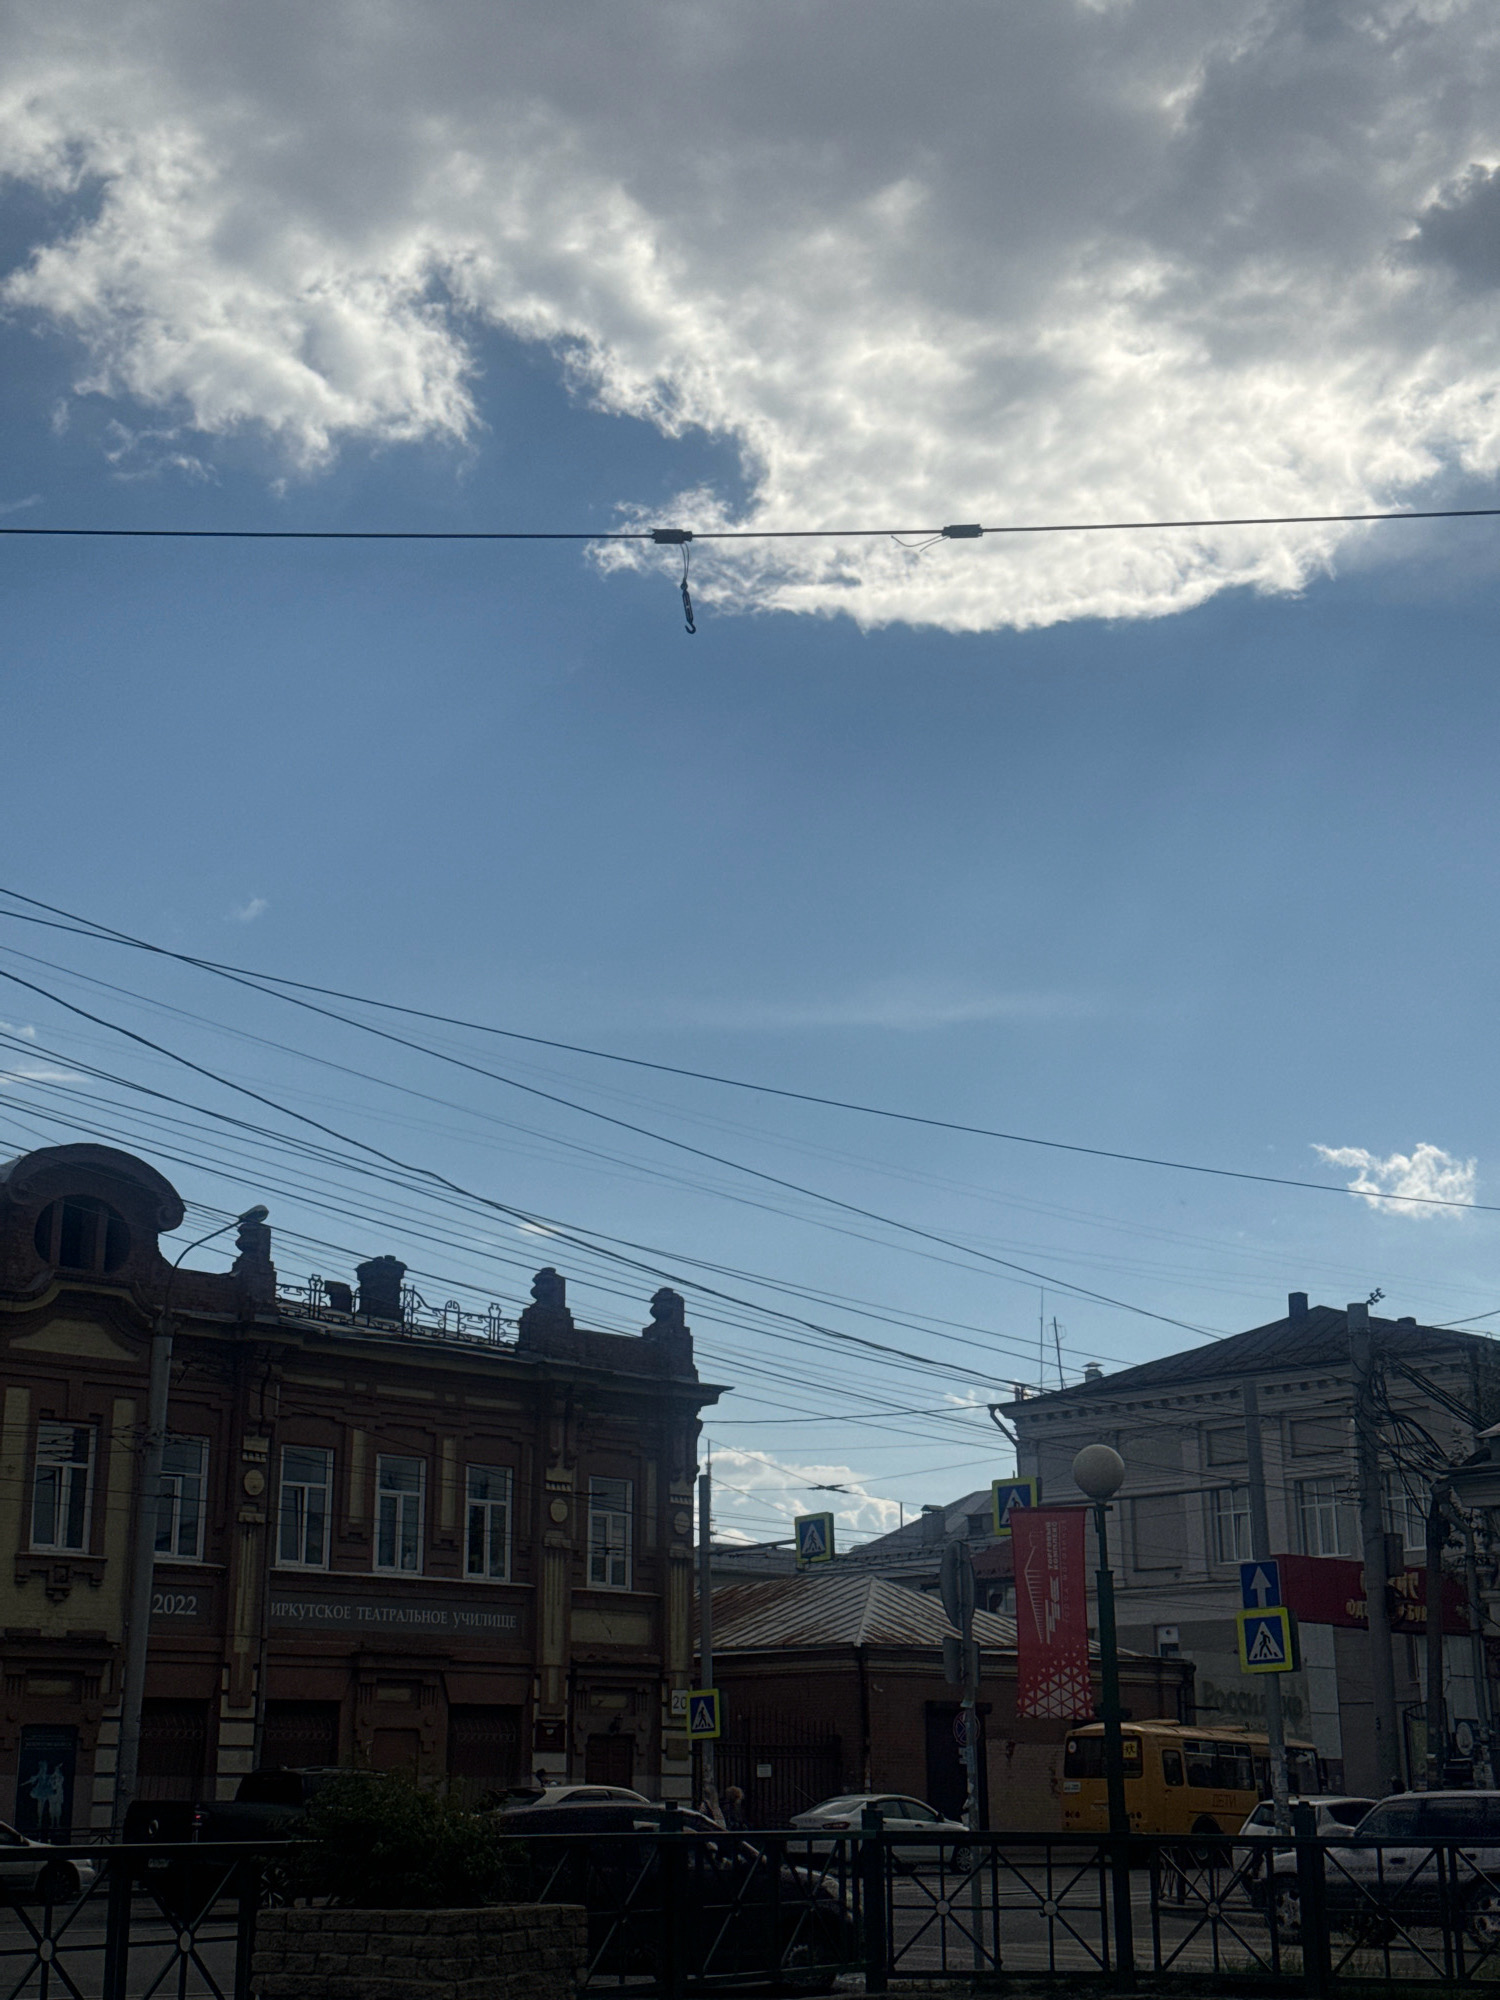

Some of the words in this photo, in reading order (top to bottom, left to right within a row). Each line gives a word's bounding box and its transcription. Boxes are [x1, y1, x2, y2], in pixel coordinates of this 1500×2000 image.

[152, 1593, 198, 1616] 2022
[271, 1602, 352, 1620] ИРКУТСКОЕ
[356, 1606, 448, 1625] ТЕАТРАЛЬНОЕ
[452, 1611, 517, 1630] УЧИЛИЩЕ
[1211, 1793, 1237, 1808] ДЕТИ
